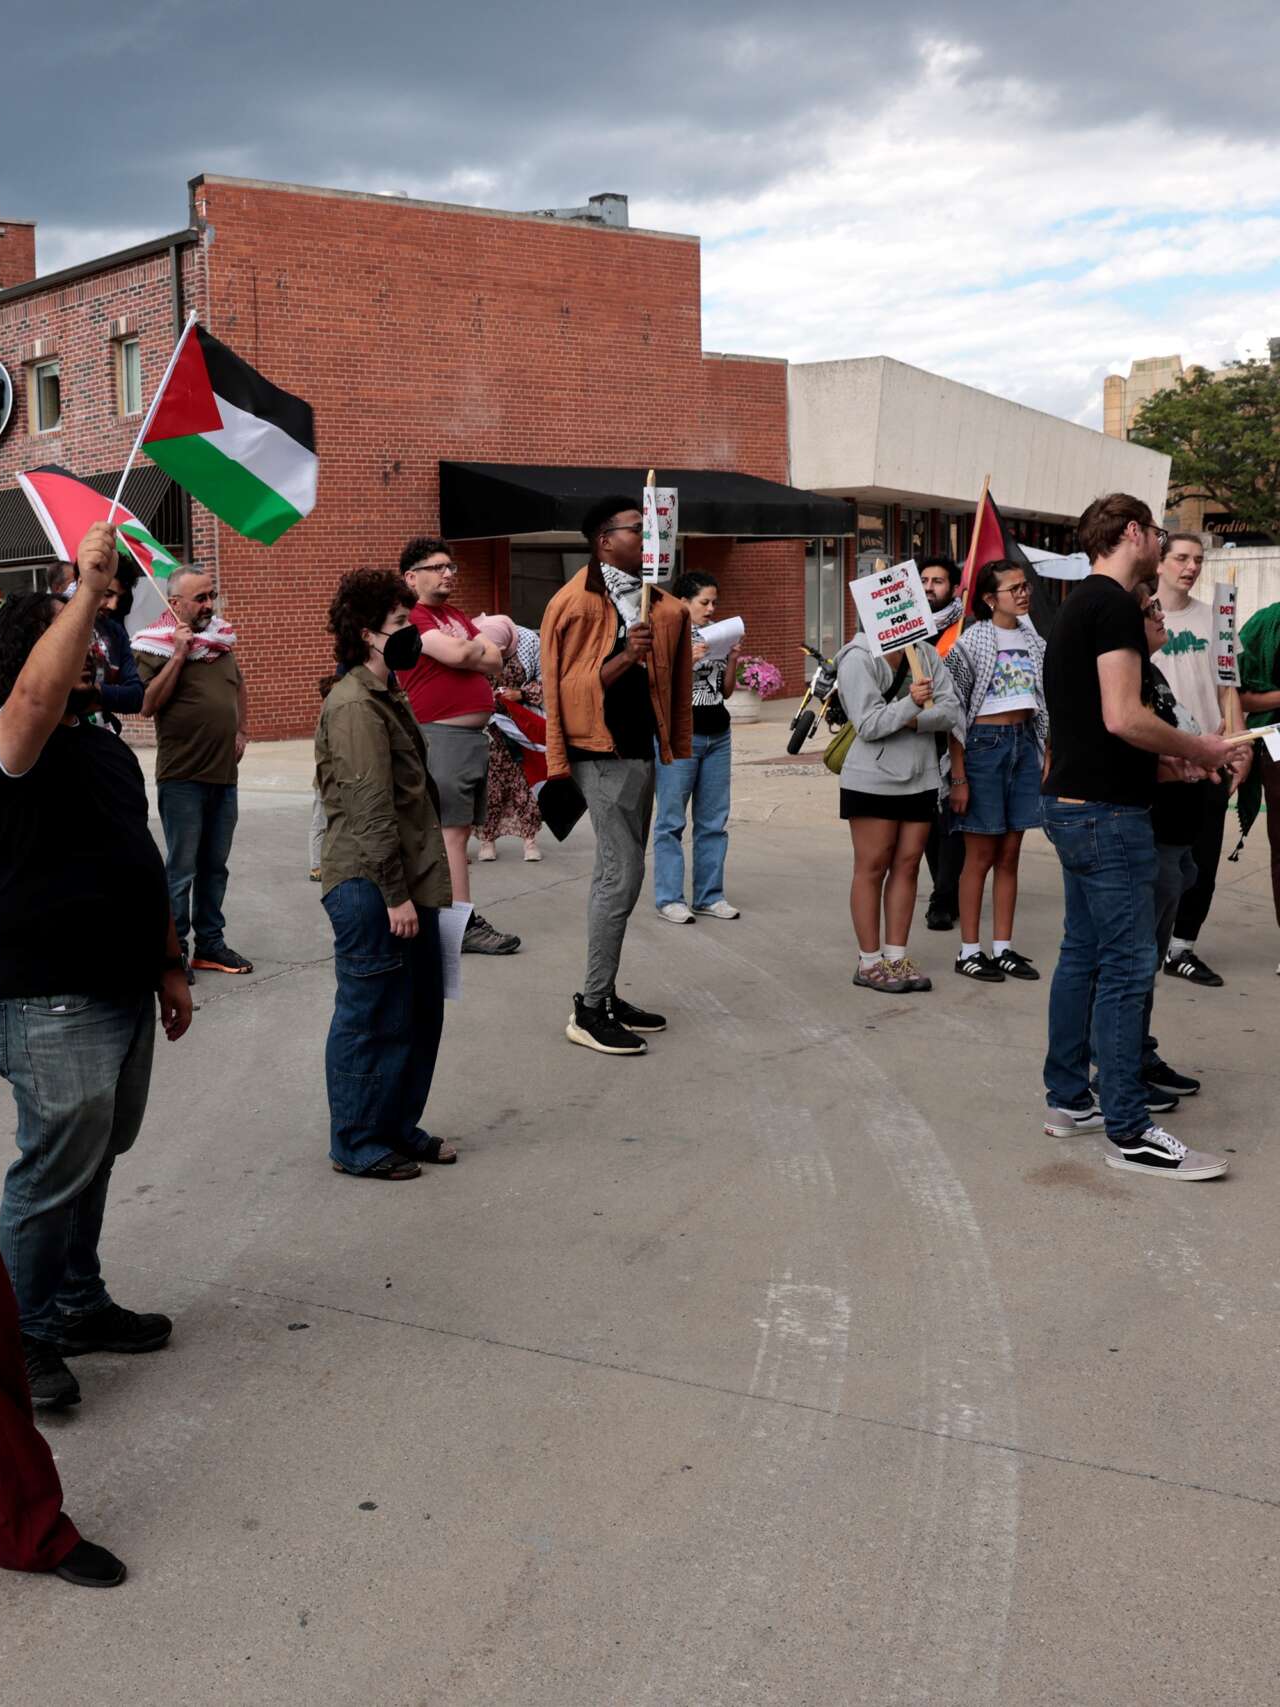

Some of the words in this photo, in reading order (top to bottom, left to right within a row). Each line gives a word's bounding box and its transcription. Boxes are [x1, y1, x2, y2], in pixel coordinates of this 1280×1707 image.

[879, 575, 892, 585] NO
[870, 581, 905, 599] DETROIT
[884, 594, 901, 605] TAX
[876, 600, 914, 619] DOLLARS
[890, 613, 908, 625] FOR
[878, 617, 925, 641] GENOCIDE
